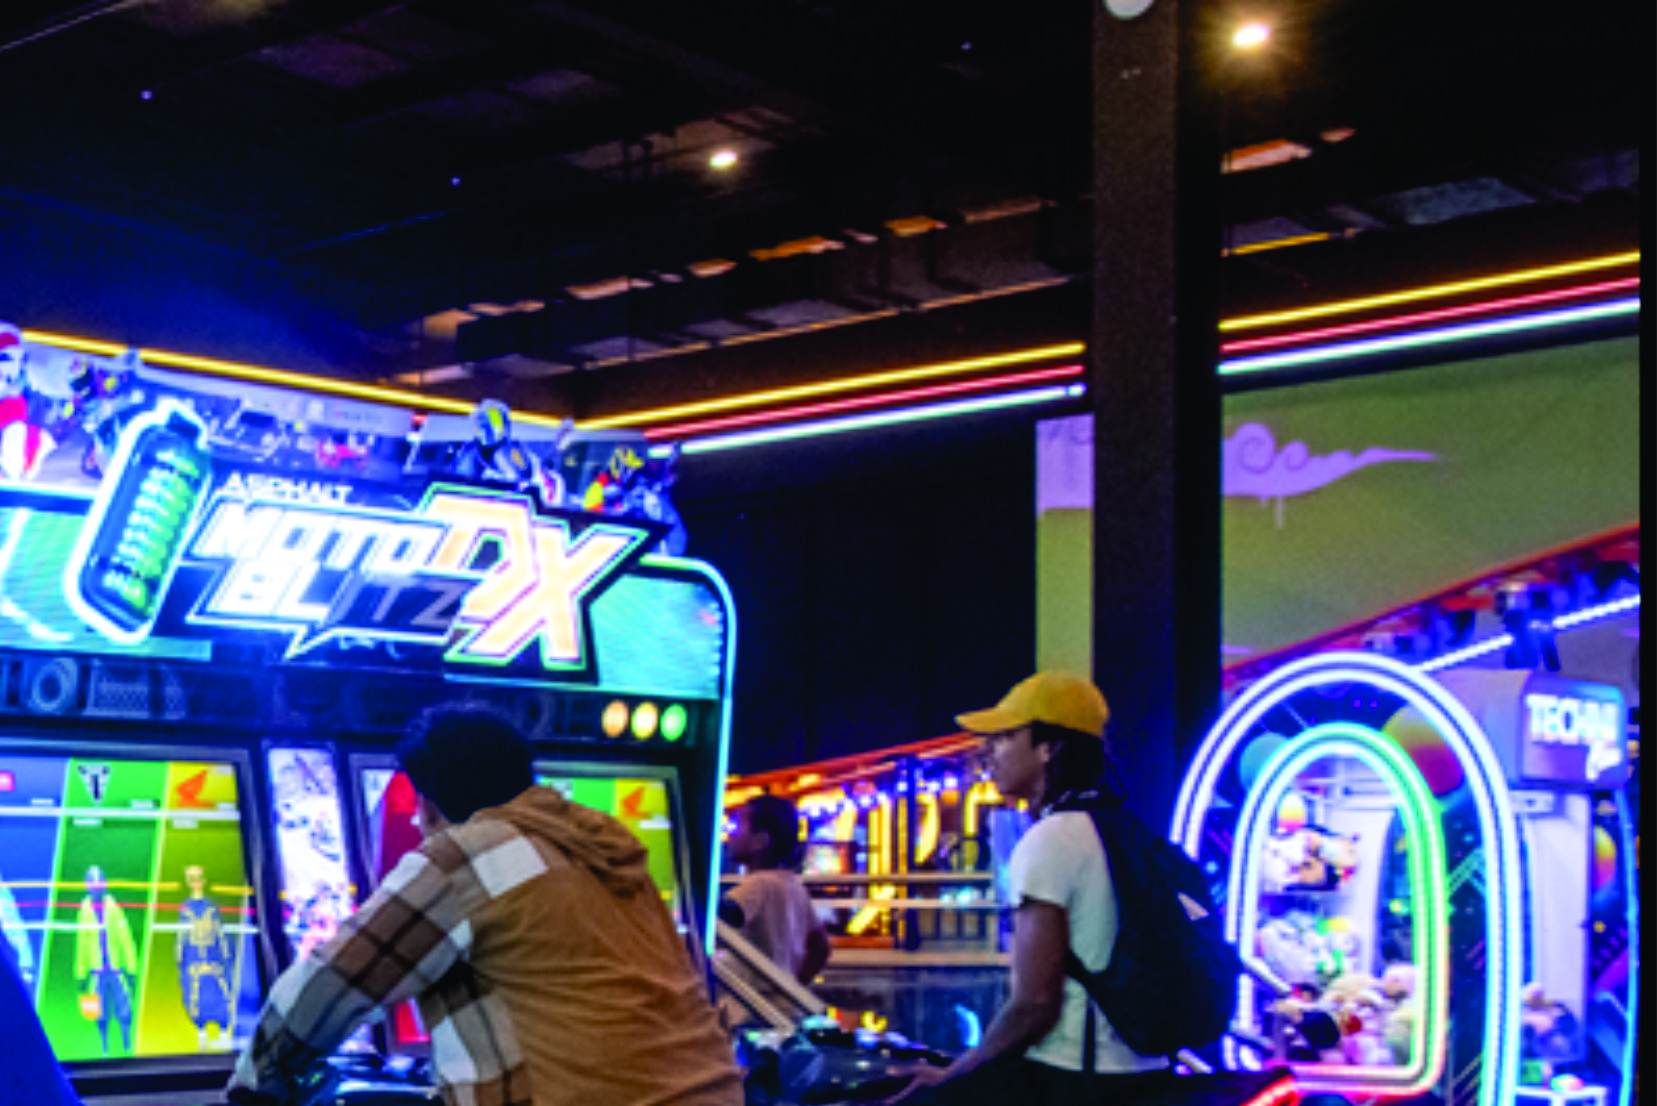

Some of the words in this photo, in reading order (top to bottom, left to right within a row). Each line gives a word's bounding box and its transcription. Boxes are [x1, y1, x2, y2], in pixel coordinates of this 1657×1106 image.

[225, 472, 354, 504] ASPHALT
[191, 501, 447, 572] MOTO
[205, 558, 463, 628] BLITZ
